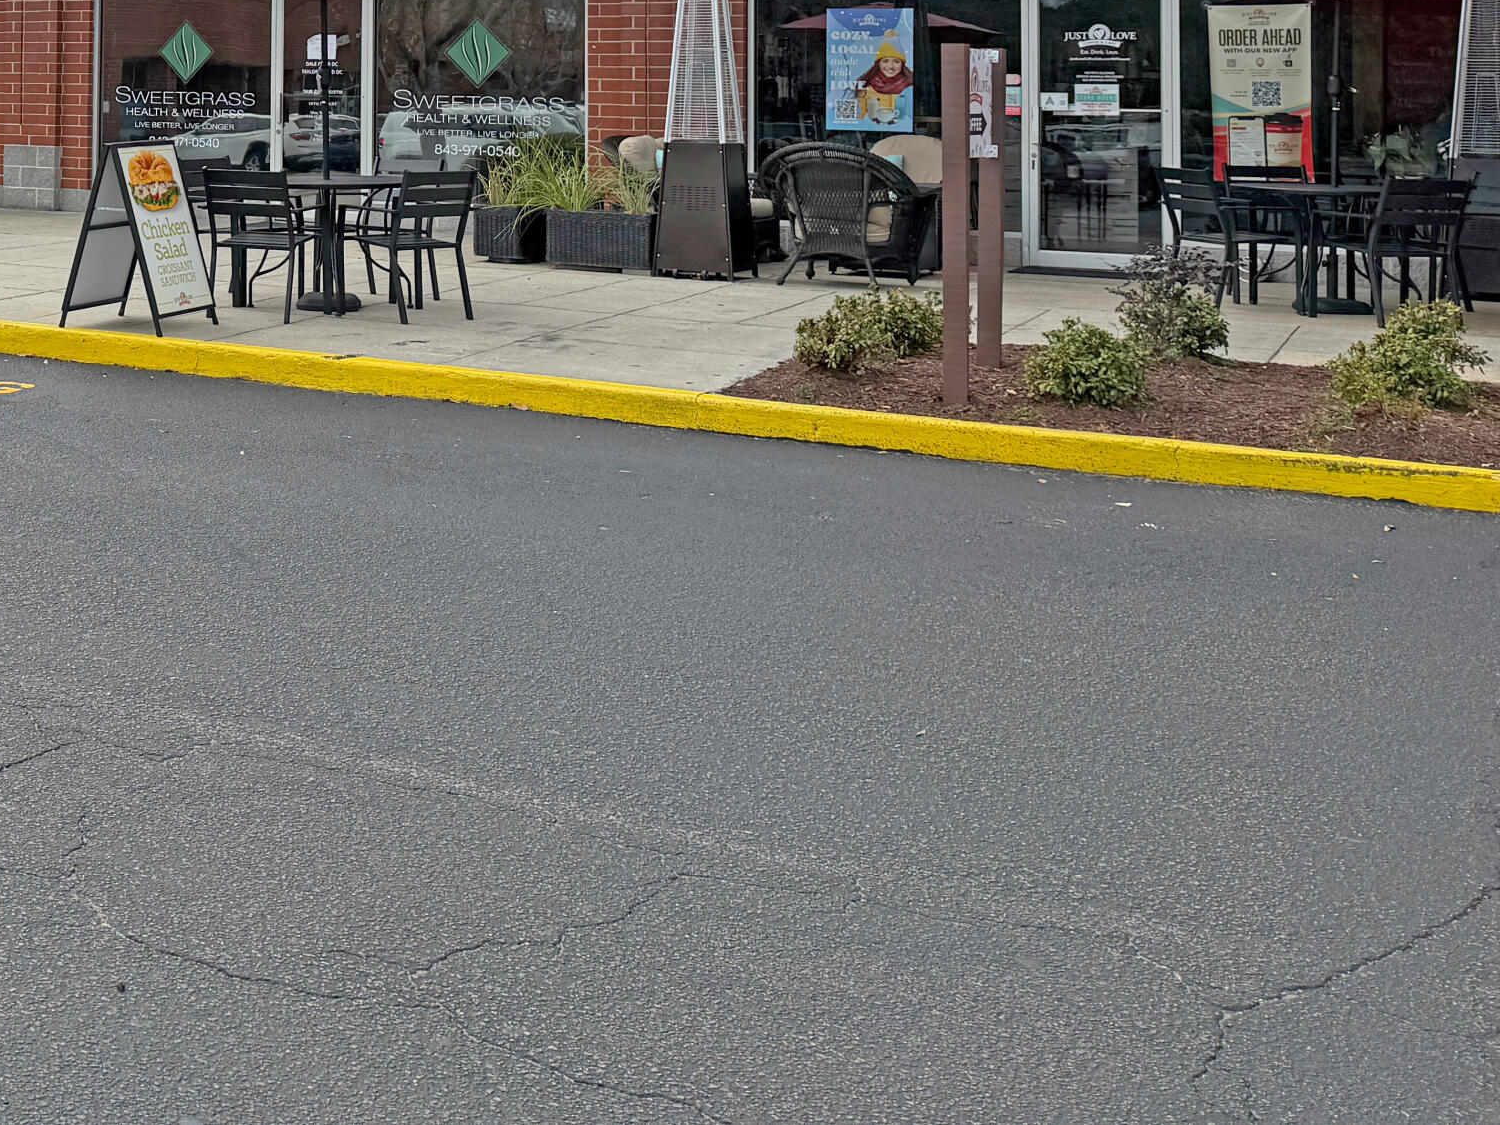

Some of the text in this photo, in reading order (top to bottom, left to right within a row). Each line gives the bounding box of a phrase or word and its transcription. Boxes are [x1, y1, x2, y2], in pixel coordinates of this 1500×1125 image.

[830, 30, 873, 41] COZY.
[1063, 31, 1137, 42] JUST LOVE
[1219, 28, 1302, 46] ORDER AHEAD
[830, 80, 870, 91] LOVE.
[115, 85, 256, 107] SWEETGRASS
[393, 89, 566, 113] SWEETGRASS
[125, 107, 245, 119] HEALTH & WELLNESS
[406, 113, 551, 127] HEALTH & WELLNESS
[151, 121, 183, 130] BETTER,
[184, 122, 200, 130] LIVE
[201, 123, 236, 131] LONGER
[416, 128, 436, 136] LIVE
[477, 130, 497, 138] LIVE
[499, 131, 540, 139] LONGER
[434, 143, 521, 158] 843-971-0540
[141, 217, 191, 241] Chicken
[154, 236, 189, 260] Salad
[157, 260, 194, 276] CROISSANT
[160, 272, 197, 287] SANDWICH
